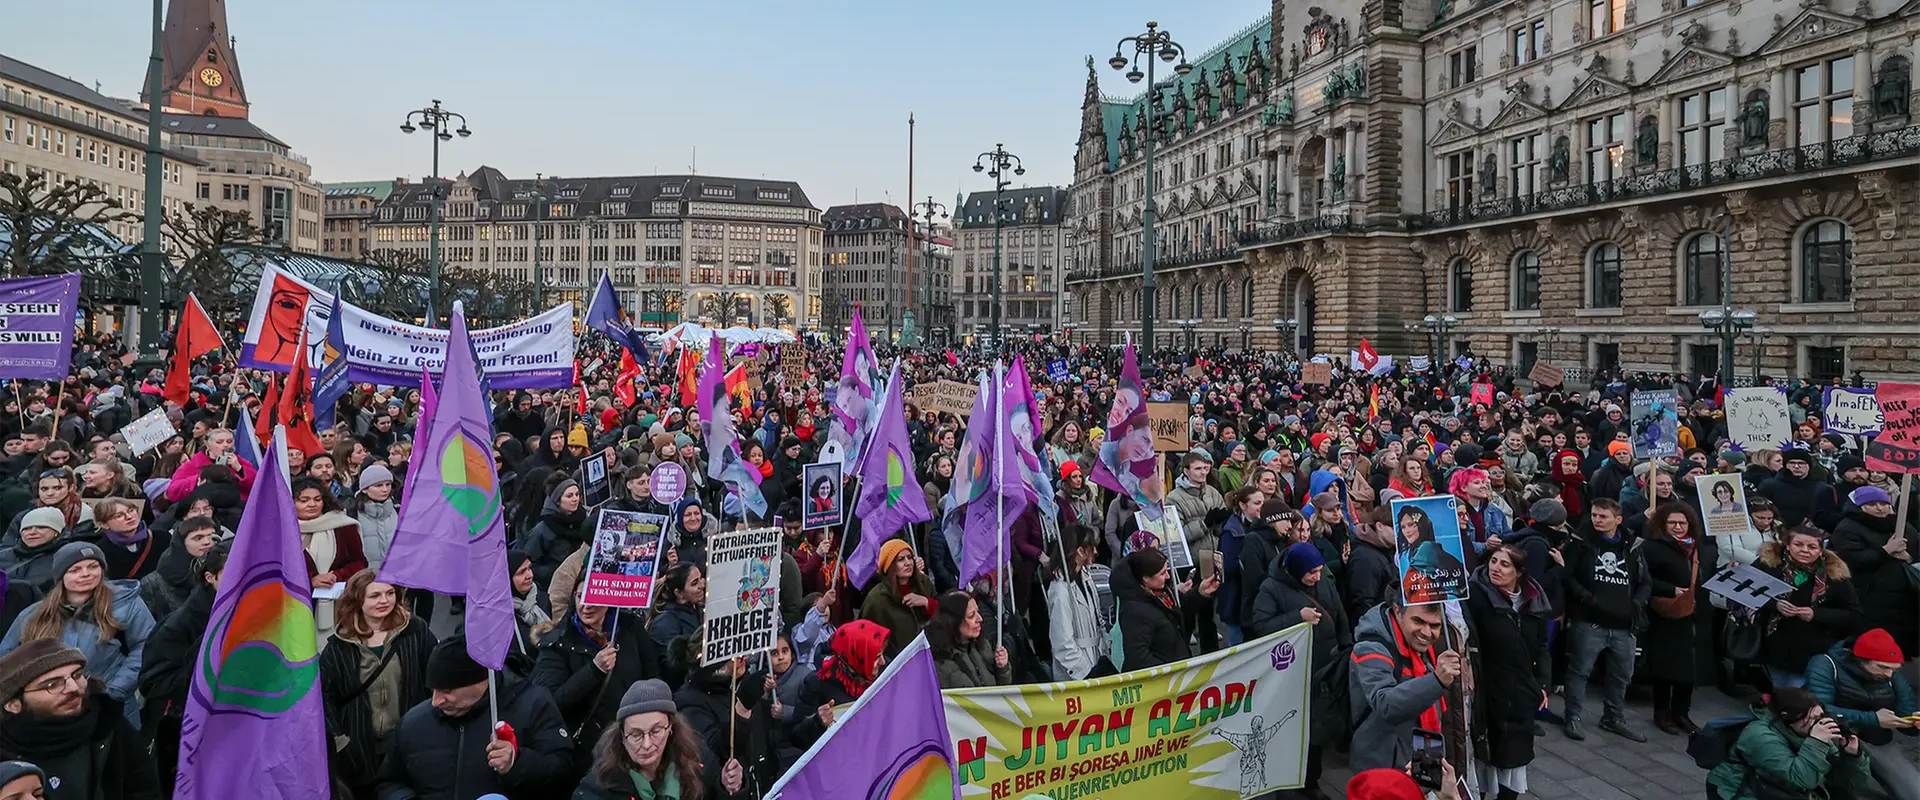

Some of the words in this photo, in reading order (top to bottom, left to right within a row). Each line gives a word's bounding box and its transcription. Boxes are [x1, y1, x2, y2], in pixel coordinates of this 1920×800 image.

[6, 304, 58, 313] STEHT
[15, 333, 60, 342] WILL!
[346, 343, 383, 363] Nein
[388, 355, 409, 366] zu
[501, 350, 558, 366] Frauen!
[410, 345, 440, 354] von
[533, 369, 563, 377] Hamburg
[1882, 400, 1908, 412] KEEP
[1826, 412, 1856, 430] What's
[1857, 424, 1875, 433] your
[1746, 433, 1772, 442] THIS!
[1891, 430, 1908, 442] OFF
[1265, 512, 1294, 523] SANKT
[712, 531, 780, 551] PATRIARCHAT
[711, 544, 778, 565] ENTWAFFNEN!
[592, 579, 609, 587] WIR
[589, 587, 647, 598] VERÄNDERUNG!
[707, 607, 774, 642] KRIEGE
[706, 630, 772, 662] BEENDEN
[1065, 696, 1083, 716] BI
[1112, 684, 1143, 708] MIT
[1004, 707, 1135, 771] JIYAN
[1015, 769, 1046, 794] BER
[1050, 765, 1067, 783] BI
[1167, 735, 1191, 753] WE
